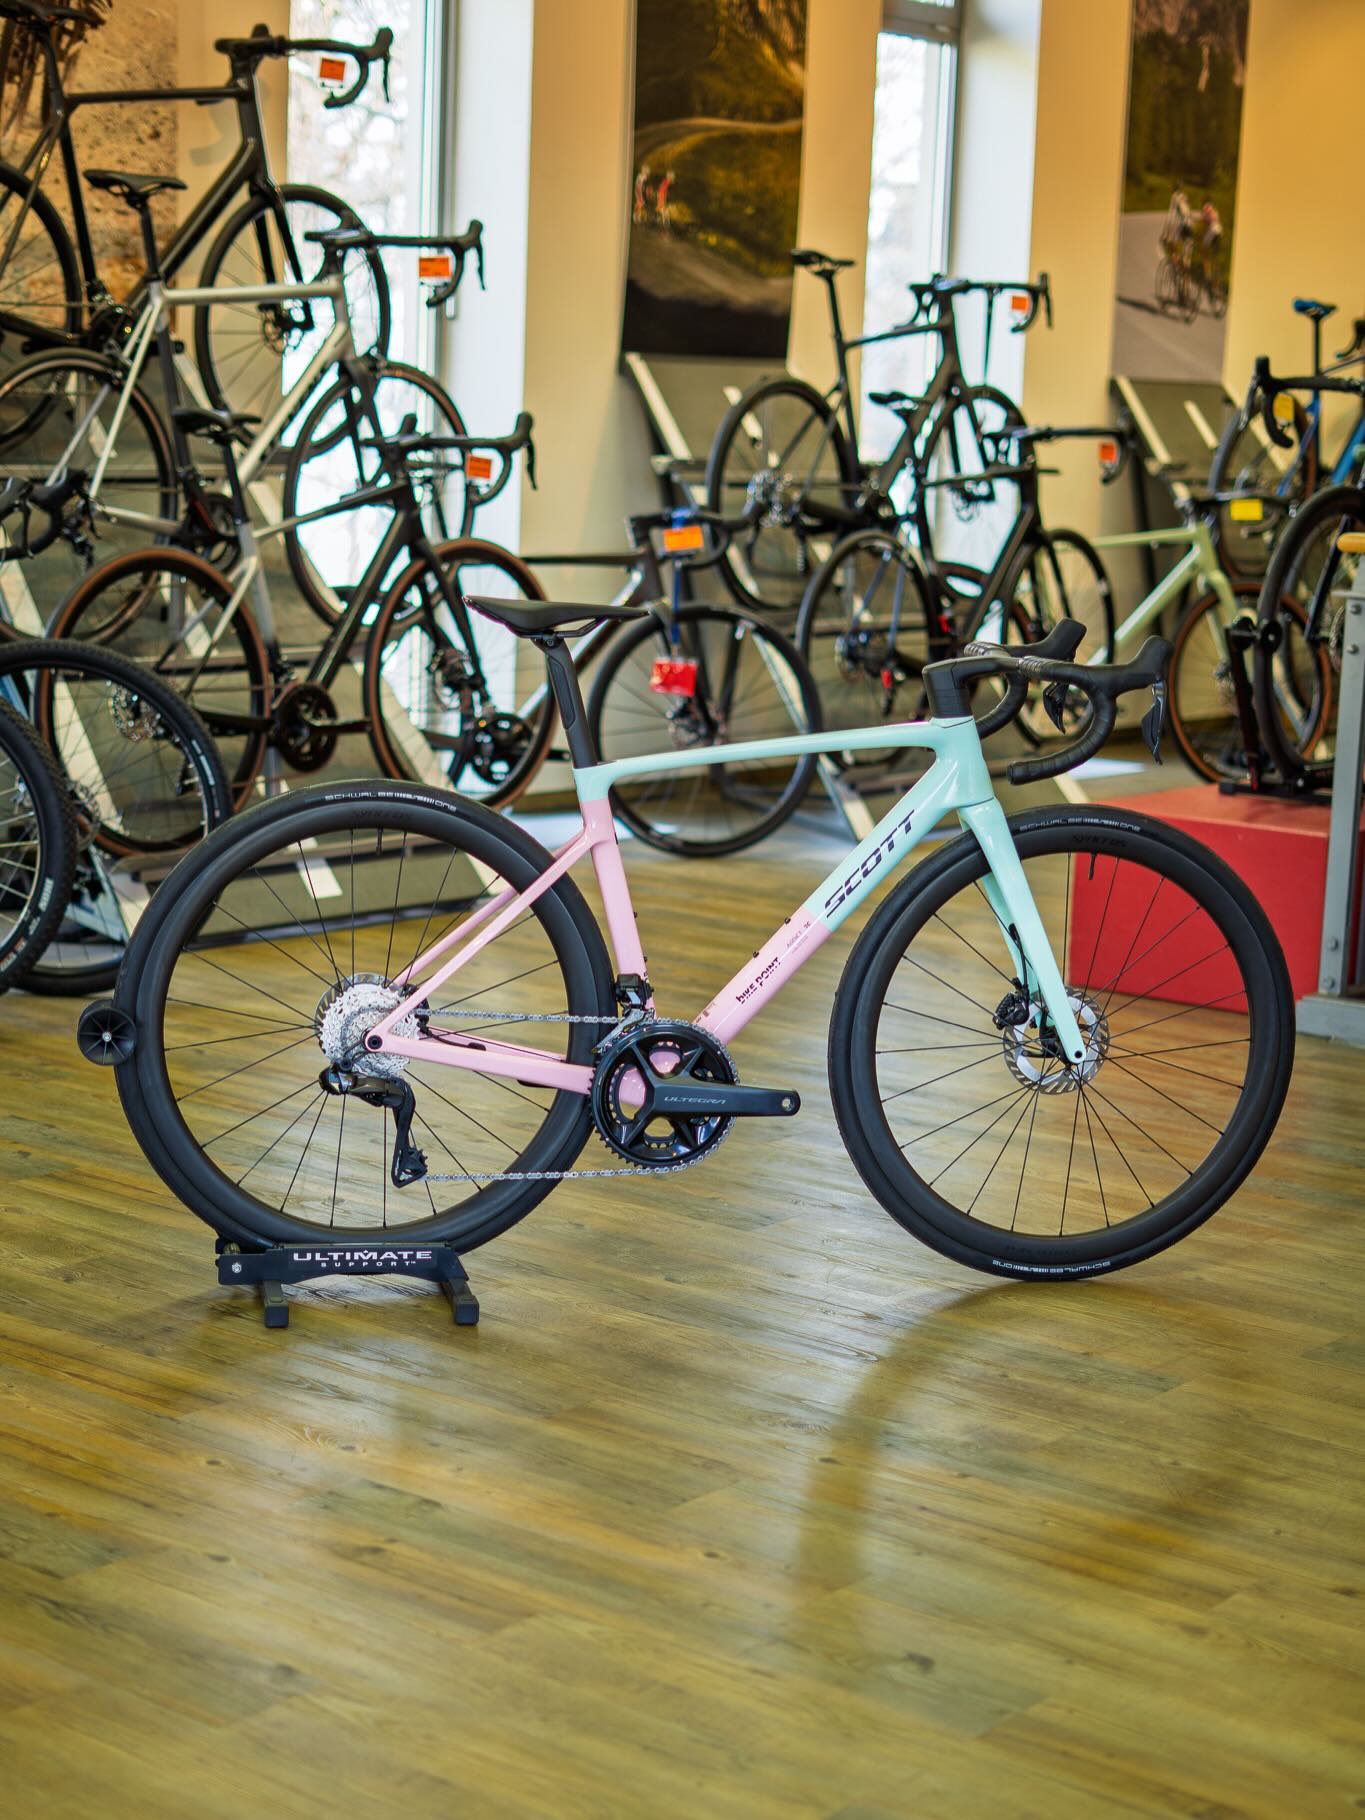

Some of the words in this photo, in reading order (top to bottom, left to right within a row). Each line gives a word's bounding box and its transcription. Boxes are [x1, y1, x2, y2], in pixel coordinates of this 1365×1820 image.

[325, 792, 393, 800] SCHWALBE
[1020, 818, 1081, 831] SCHWALBE
[825, 809, 915, 918] SCOTT
[664, 1096, 726, 1104] ULTEGRA
[293, 1250, 432, 1261] ULTIMATE
